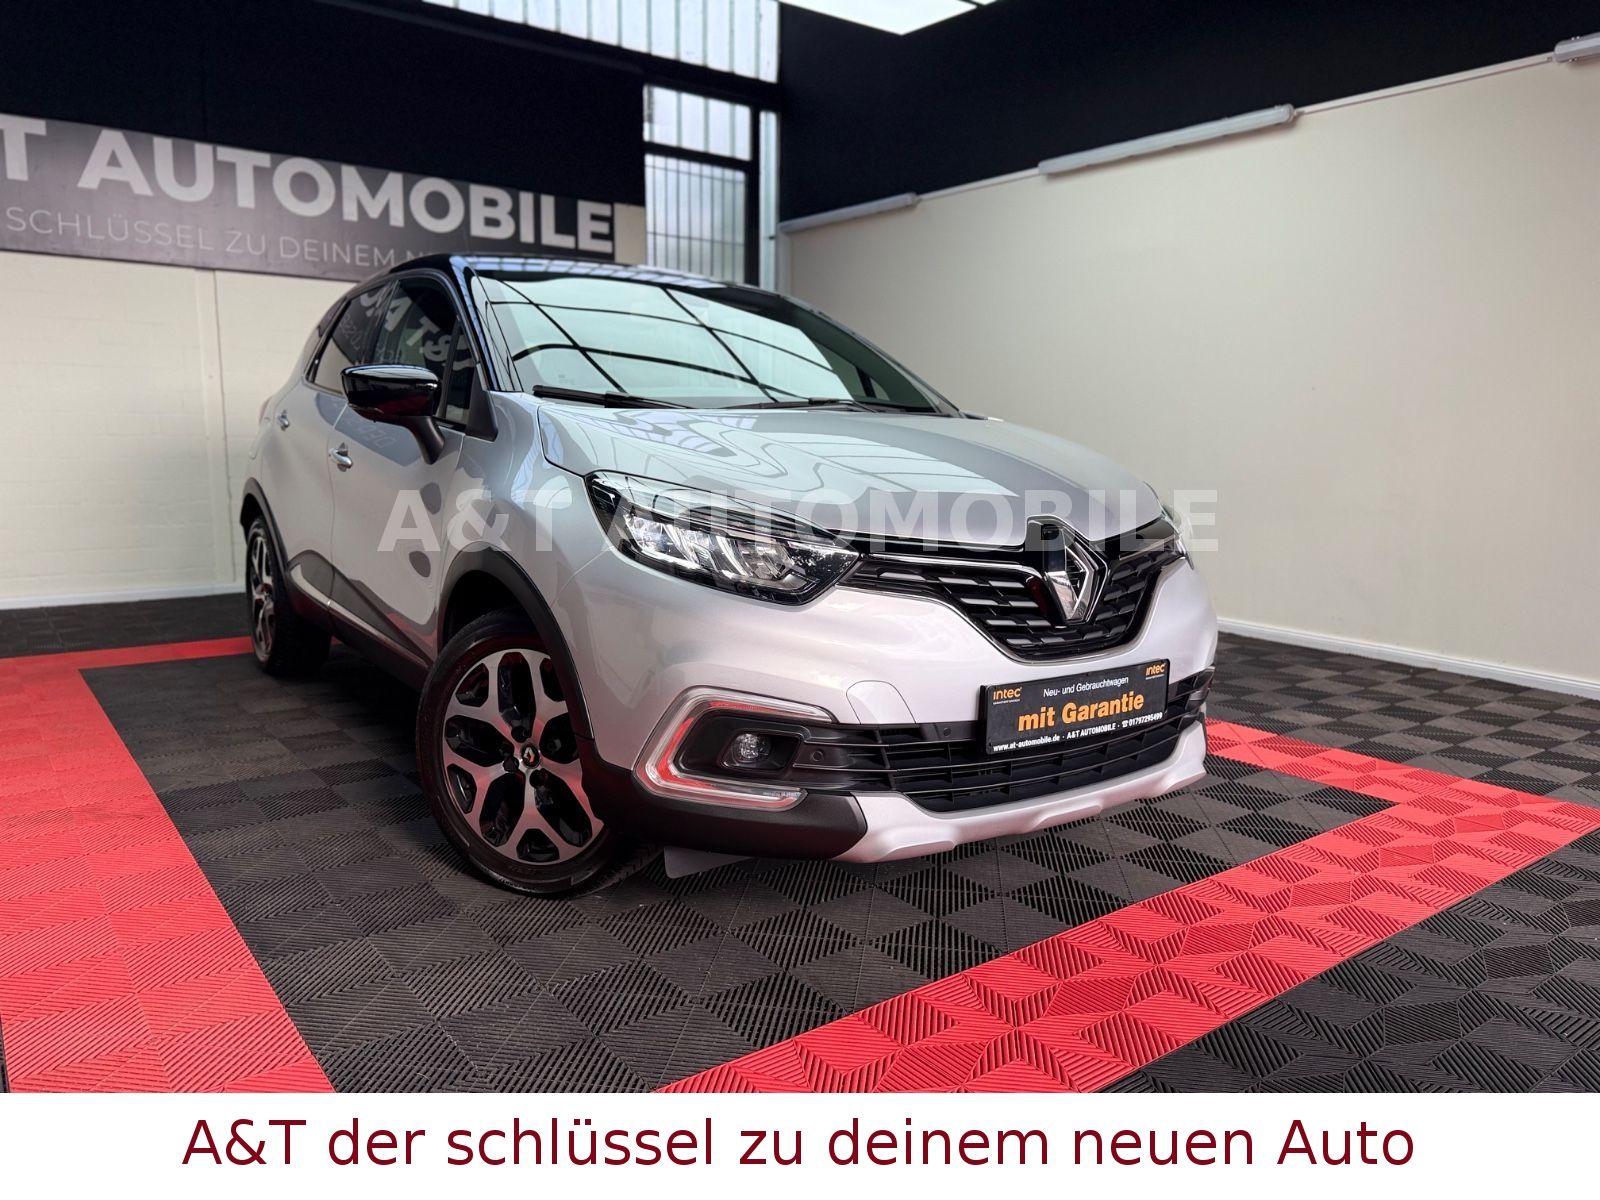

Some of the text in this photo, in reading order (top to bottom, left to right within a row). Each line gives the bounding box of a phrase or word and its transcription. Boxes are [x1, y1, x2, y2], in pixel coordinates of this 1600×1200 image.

[77, 129, 613, 254] AUTOMOBILE
[6, 206, 216, 252] SCHLÜSSEL
[225, 230, 267, 257] ZU
[279, 236, 396, 268] DEINEM
[1145, 664, 1165, 676] intec
[993, 687, 1021, 700] intec
[1043, 676, 1129, 698] Neu- und Gebrauchtwagen
[1018, 691, 1145, 732] mit Garantie
[993, 734, 1060, 752] www.at-automobile.de
[1080, 722, 1116, 737] AUTOMOBILE
